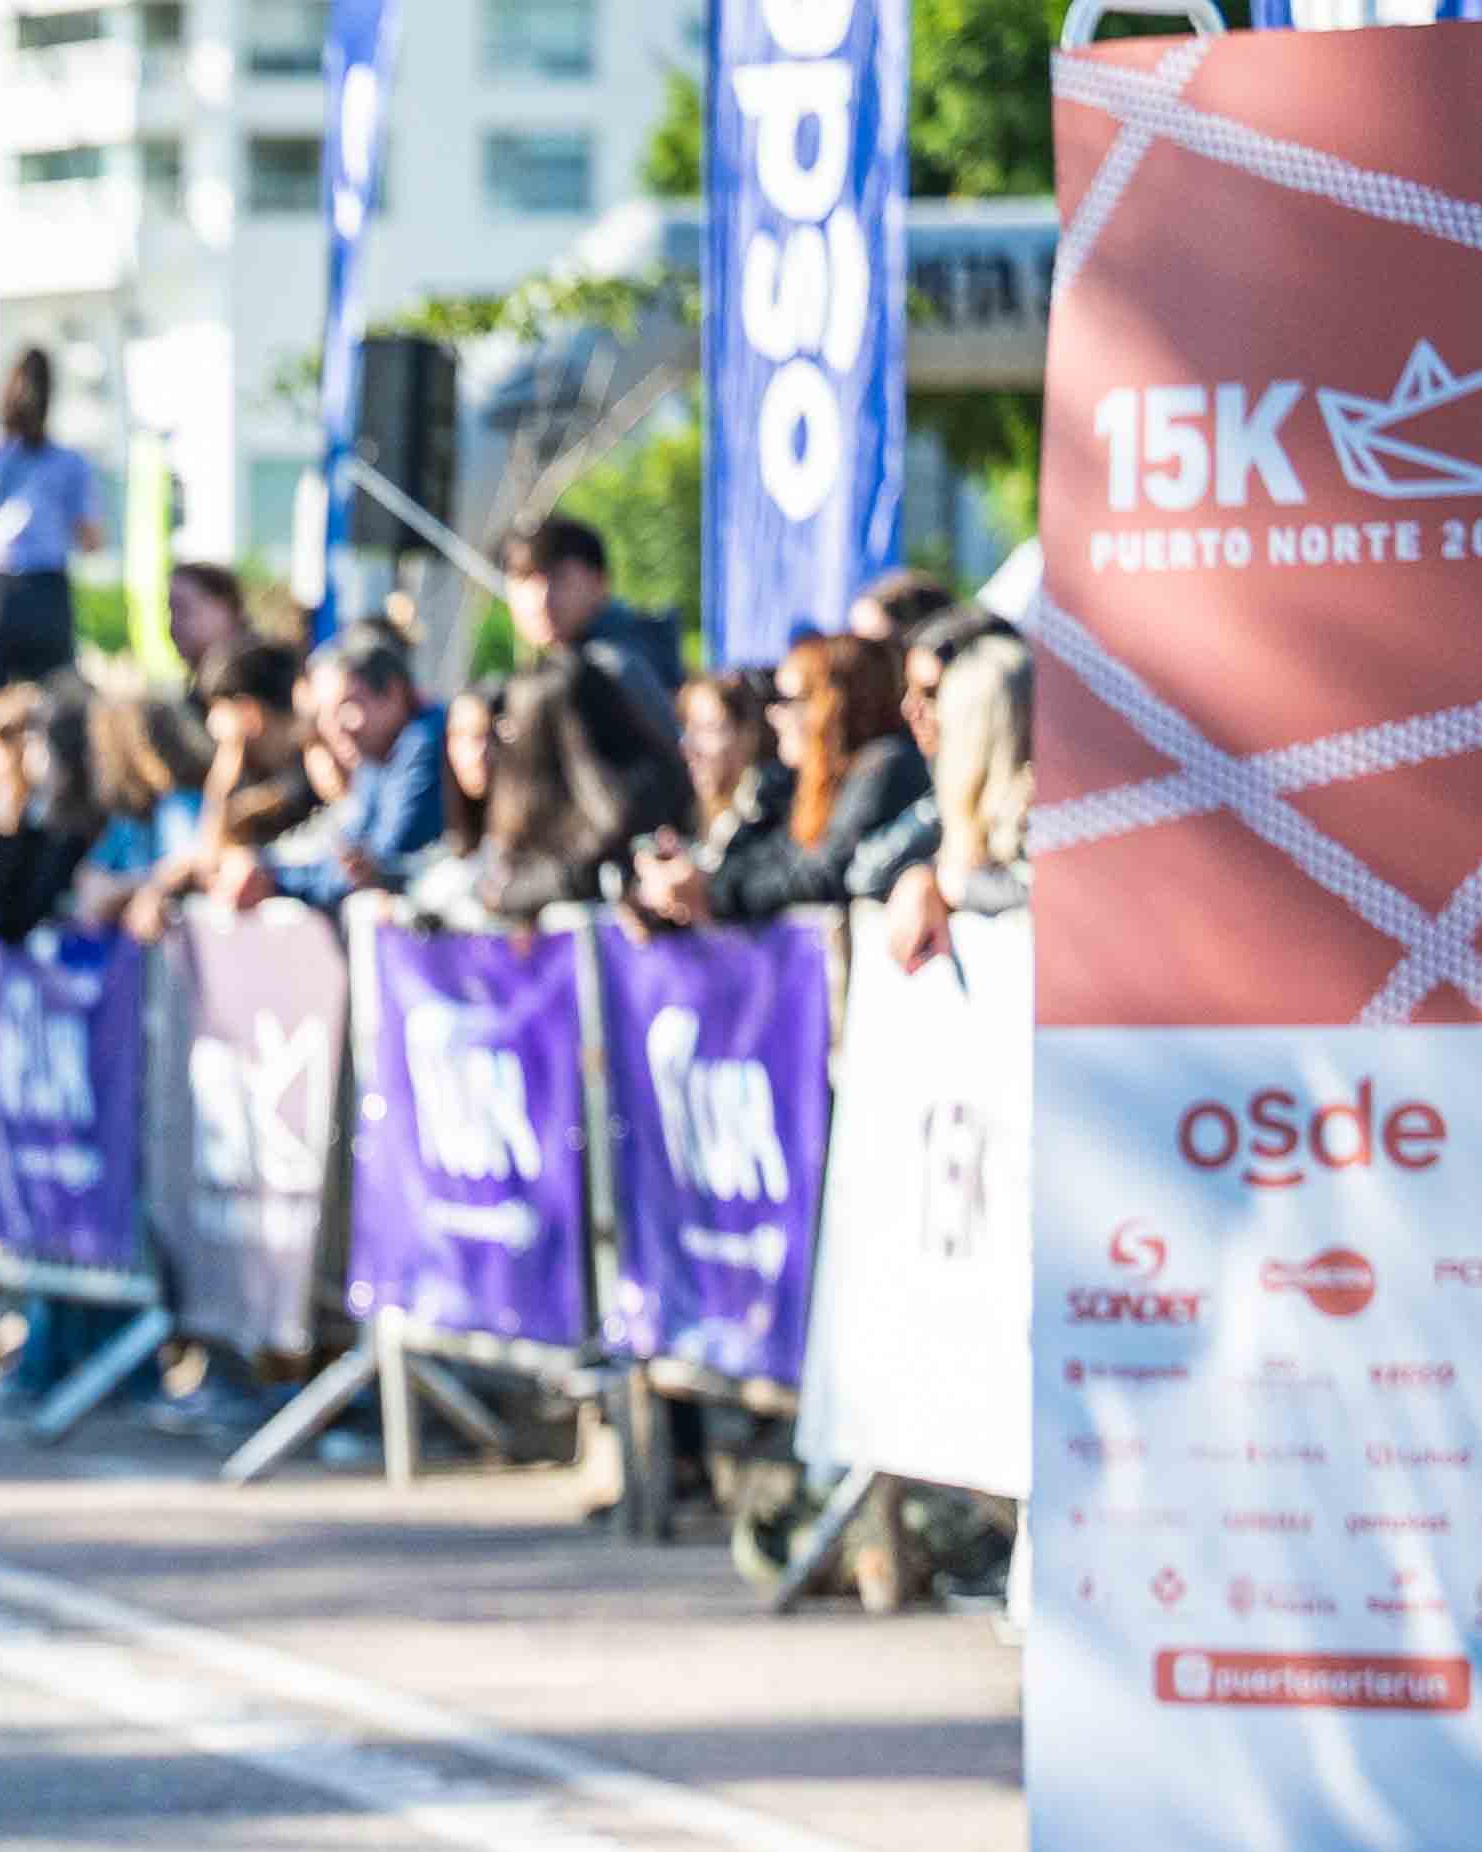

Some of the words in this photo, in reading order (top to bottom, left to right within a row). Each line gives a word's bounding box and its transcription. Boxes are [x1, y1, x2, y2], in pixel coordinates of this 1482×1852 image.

[1092, 379, 1308, 513] 15K
[1089, 526, 1252, 573] PUERTO
[1266, 519, 1422, 567] NORTE
[1176, 1074, 1448, 1190] osde
